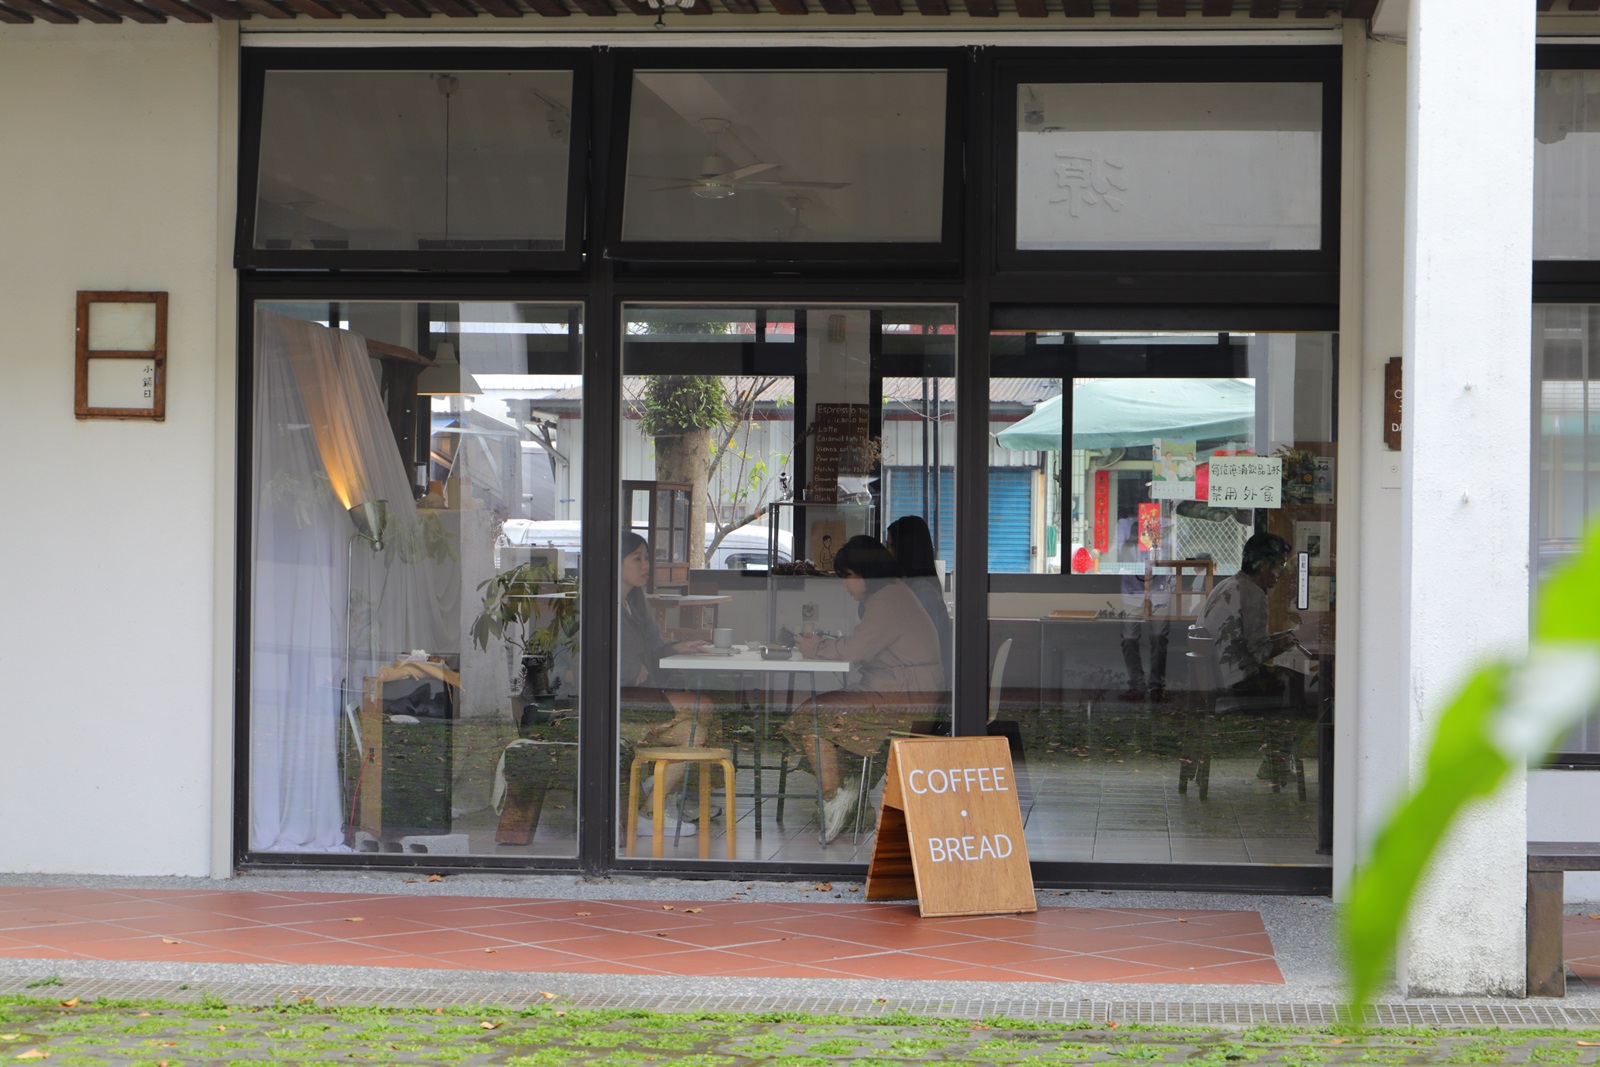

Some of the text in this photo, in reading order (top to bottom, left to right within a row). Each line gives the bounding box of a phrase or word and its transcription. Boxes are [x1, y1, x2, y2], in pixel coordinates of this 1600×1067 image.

[817, 405, 857, 415] Espresso
[1211, 485, 1274, 502] 禁用外食
[909, 767, 1008, 794] COFFEE
[928, 834, 1013, 862] BREAD
